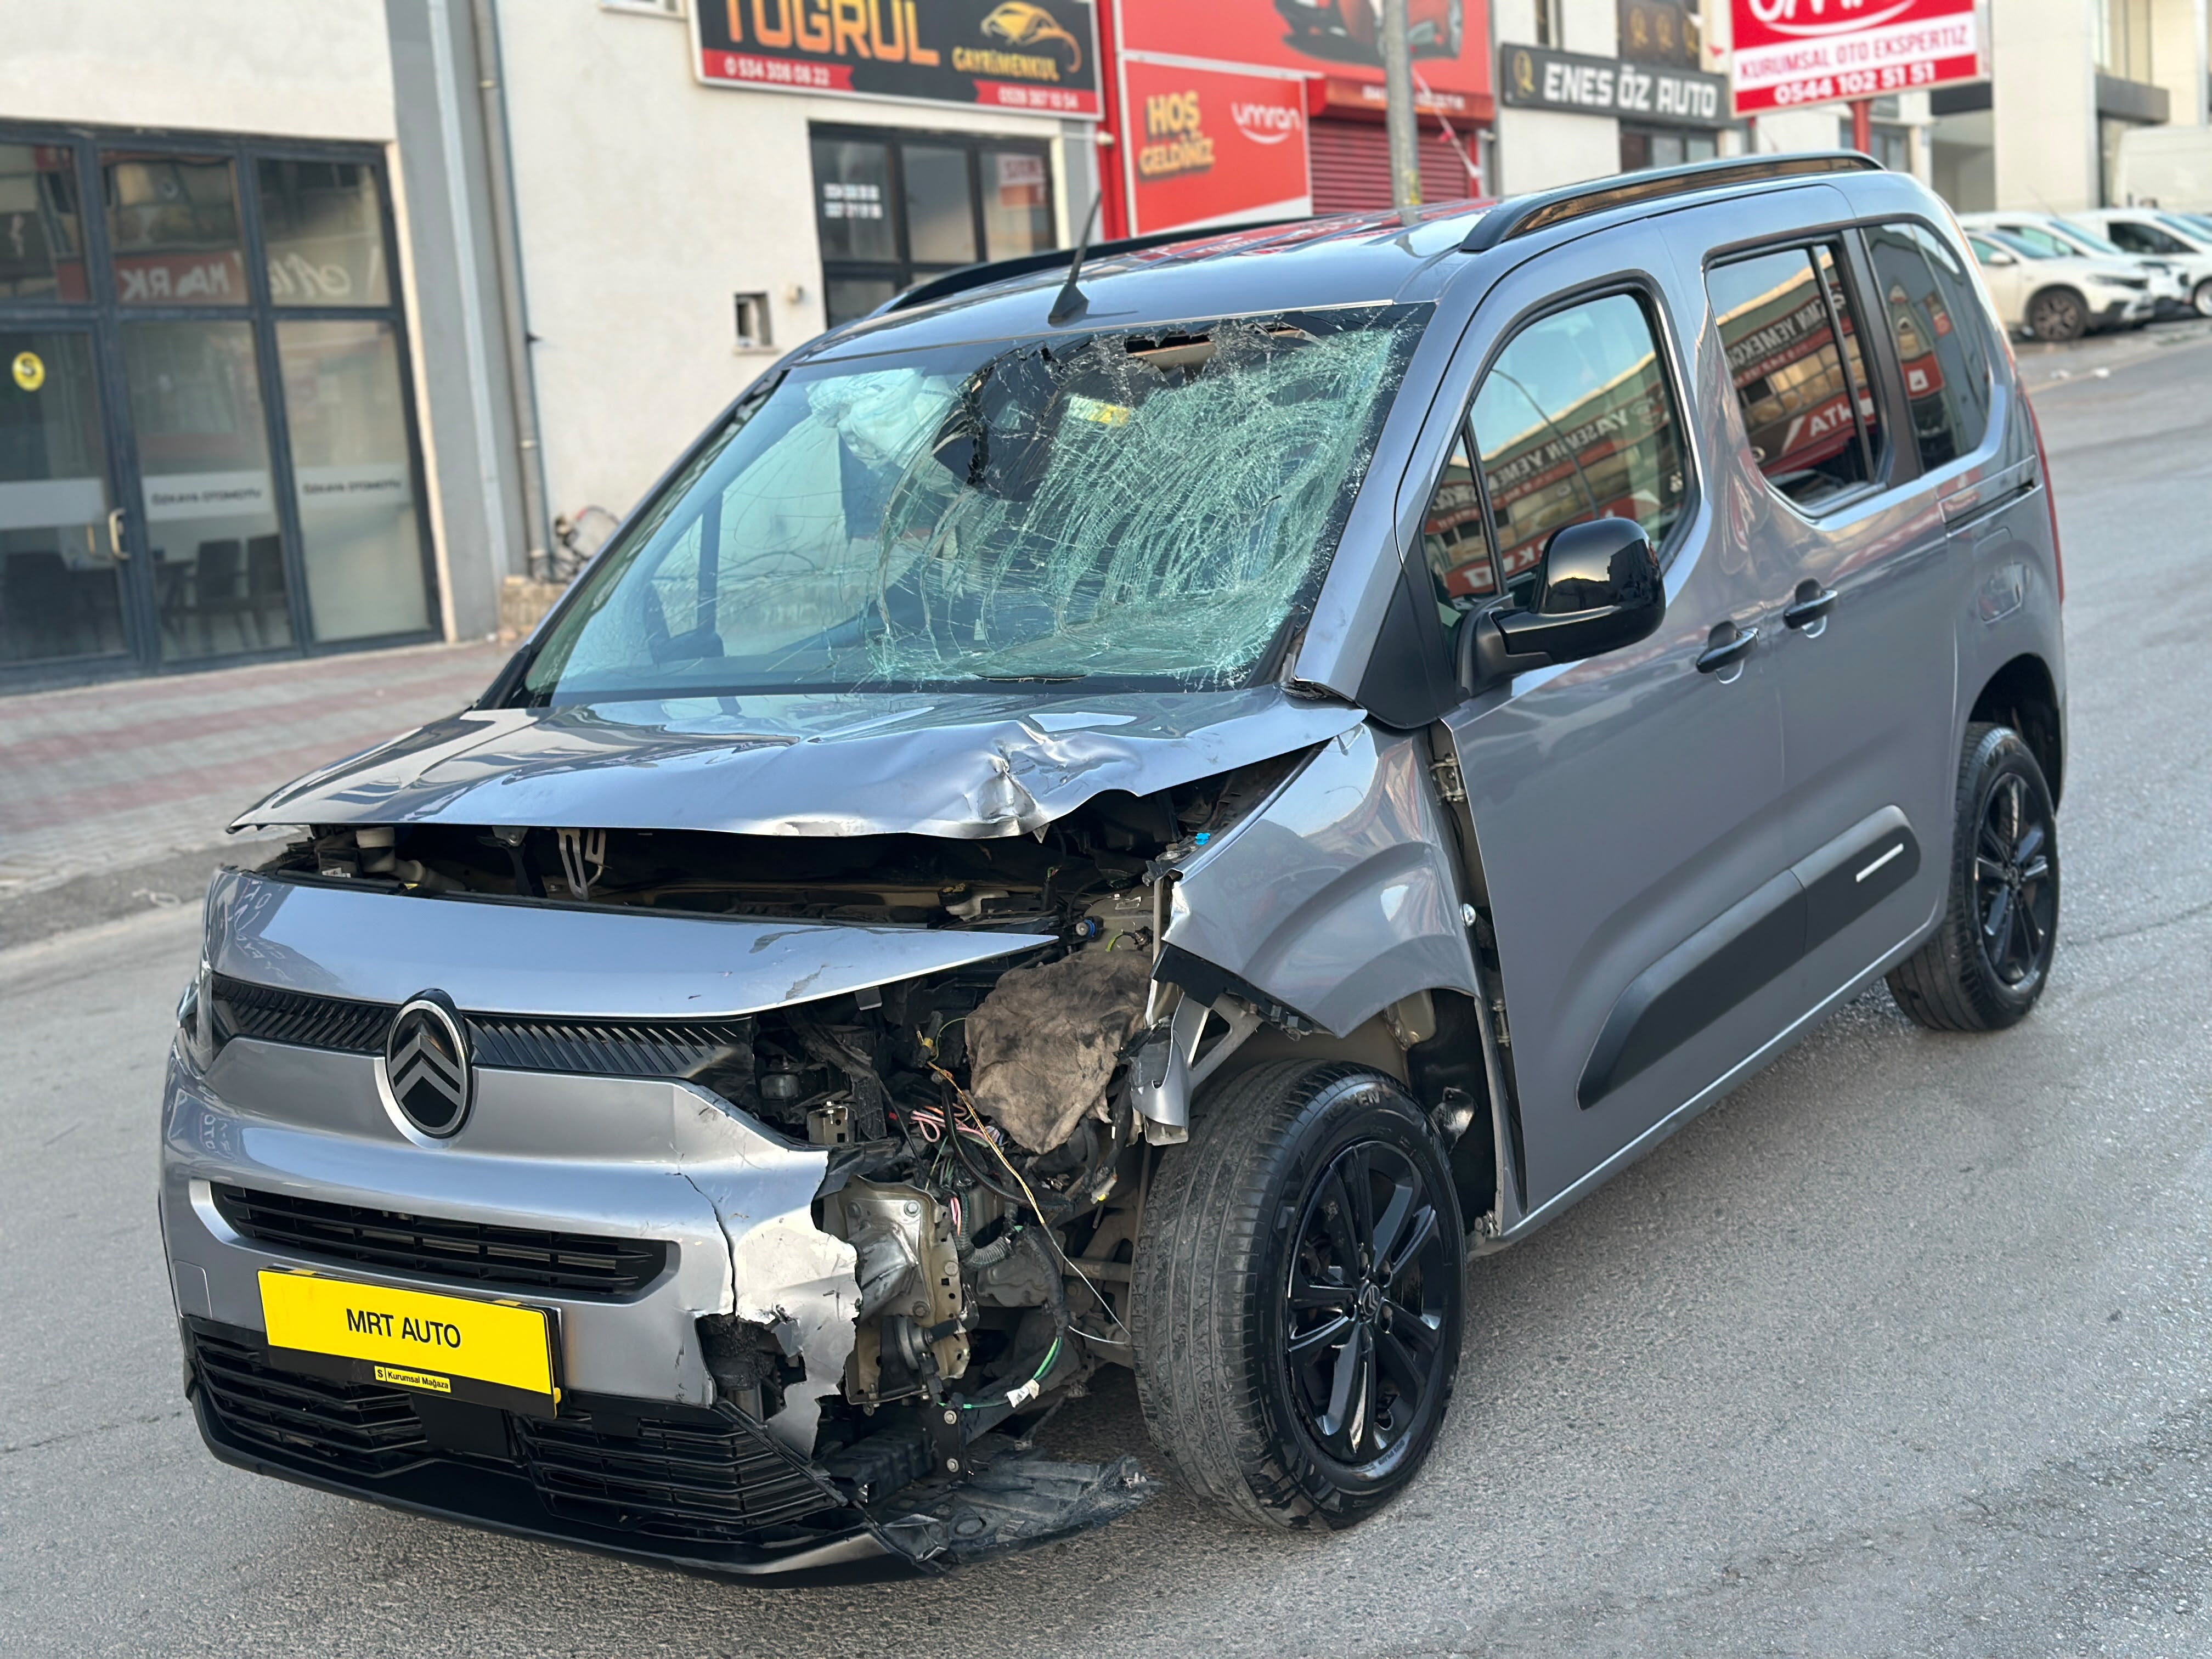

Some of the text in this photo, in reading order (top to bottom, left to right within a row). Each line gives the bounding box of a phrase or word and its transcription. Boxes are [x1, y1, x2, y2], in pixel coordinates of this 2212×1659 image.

[1740, 47, 1829, 80] KURUMSAL
[1836, 42, 1867, 65] OTO
[1543, 61, 1718, 118] ENES ÖZ AUTO
[1774, 61, 1936, 105] 0544 102 51 51
[346, 1308, 461, 1349] MRT AUTO
[377, 1369, 449, 1390] S Kurumsal Mağaza
